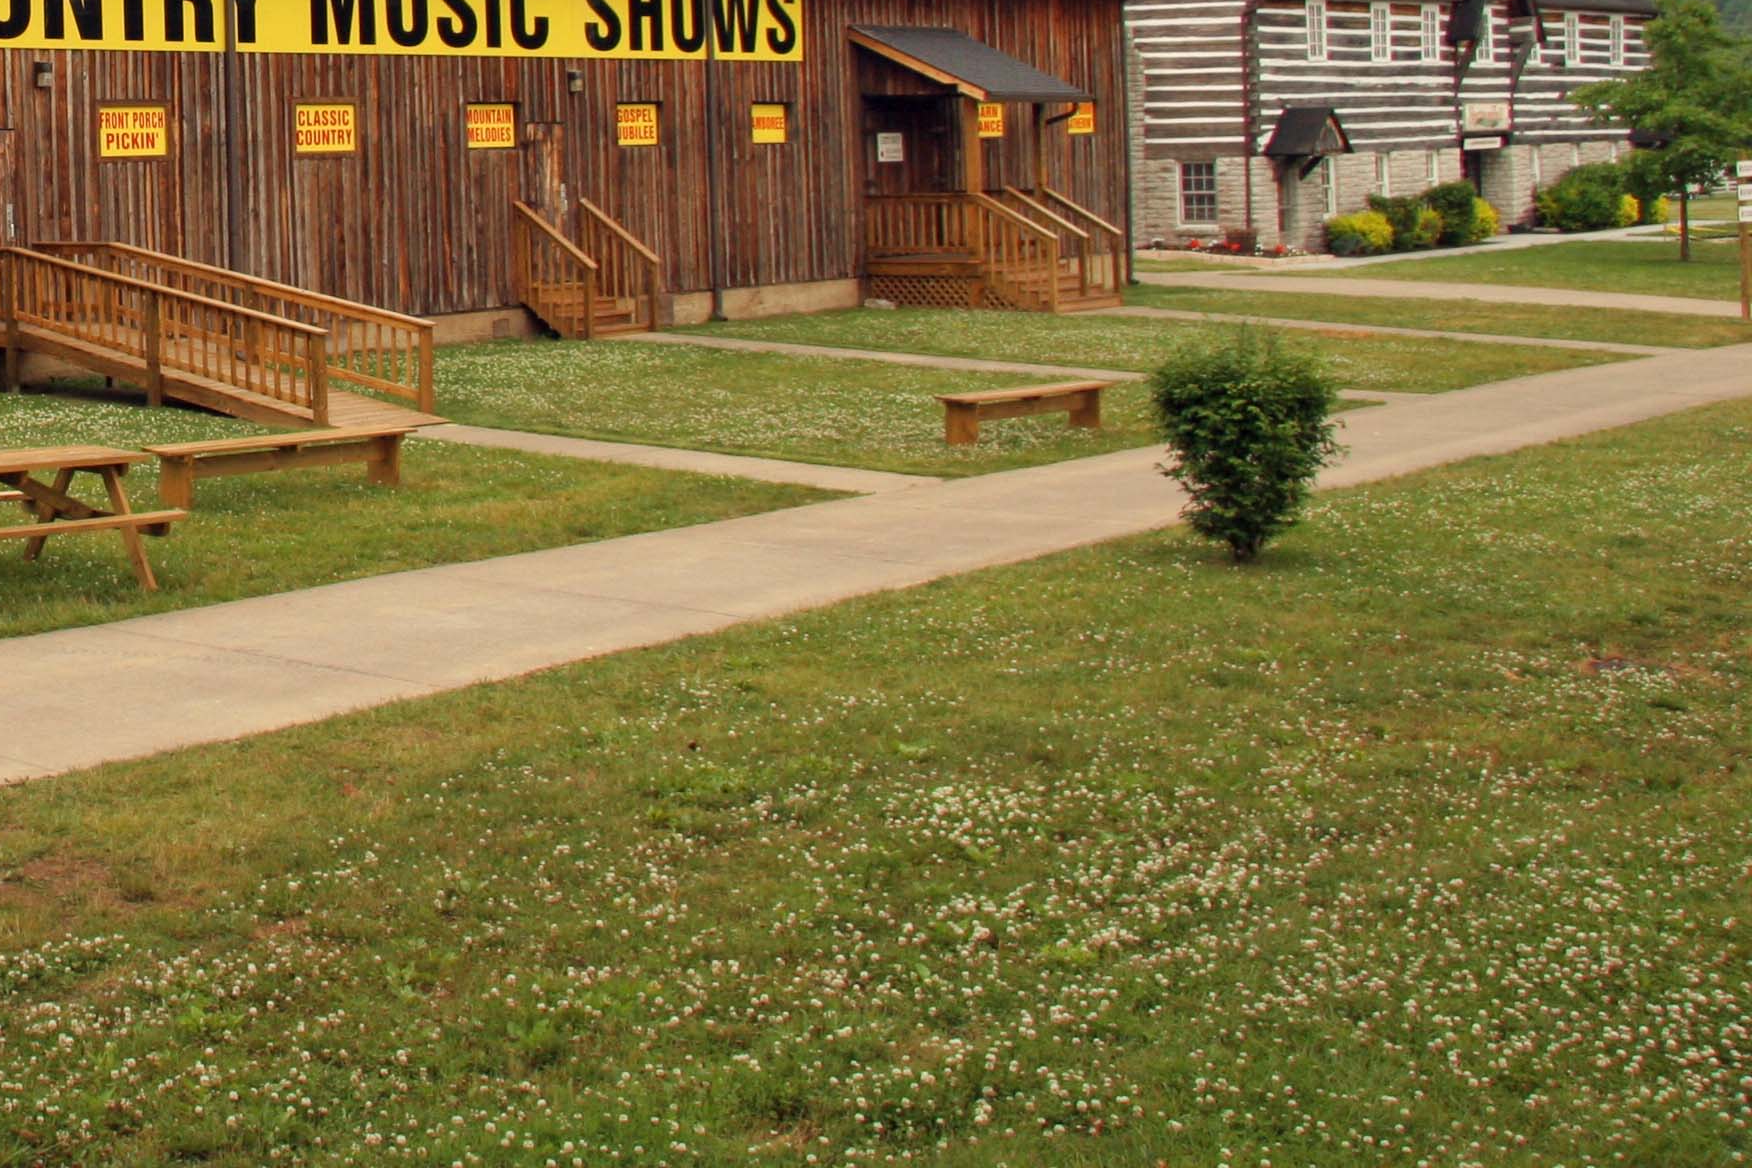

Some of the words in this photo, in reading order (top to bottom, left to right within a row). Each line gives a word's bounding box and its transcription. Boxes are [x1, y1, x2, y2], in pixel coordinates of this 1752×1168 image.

[298, 110, 349, 126] CLASSIC
[466, 109, 512, 124] MOUNTAIN
[616, 108, 653, 122] GOSPEL
[980, 105, 998, 118] ARN
[99, 112, 129, 129] FRONT
[132, 112, 164, 129] PORCH
[978, 119, 1001, 133] ANCE
[295, 130, 352, 145] COUNTRY
[467, 127, 512, 142] MELODIES
[617, 125, 655, 140] JUBILEE
[106, 132, 159, 150] PICKIN'
